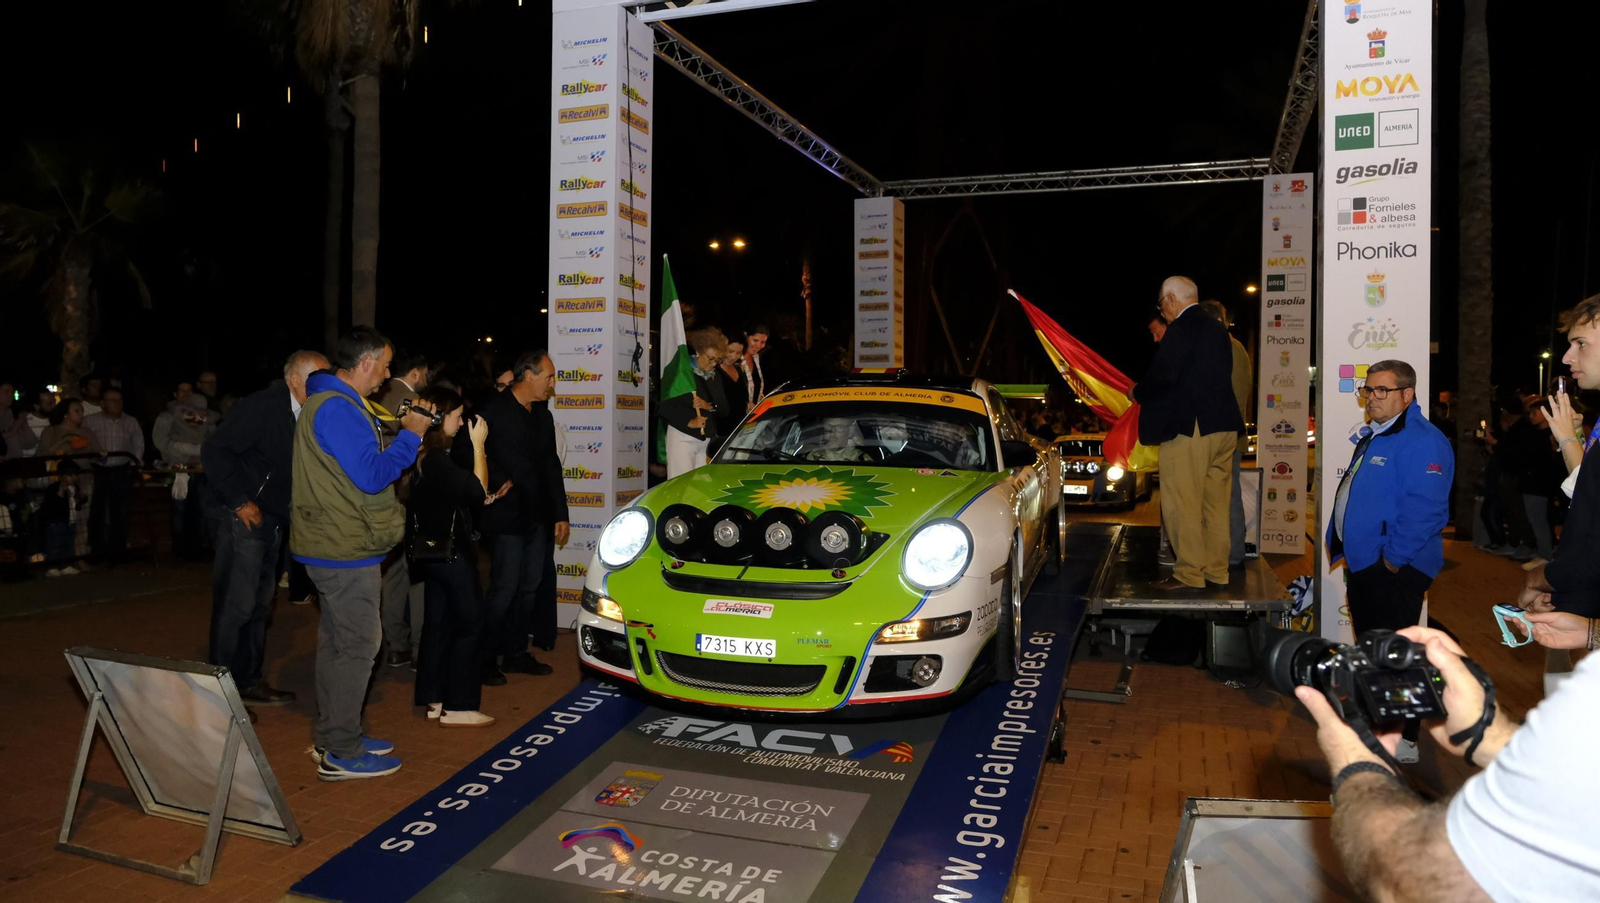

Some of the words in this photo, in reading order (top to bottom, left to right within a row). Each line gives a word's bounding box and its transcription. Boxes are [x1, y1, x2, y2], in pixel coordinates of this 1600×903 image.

[573, 37, 608, 47] MICHELIN
[1344, 61, 1385, 71] Ayuntamiento
[561, 82, 608, 94] Rallycar
[1335, 72, 1420, 100] MOYA
[568, 107, 599, 119] Recalvi
[1338, 125, 1371, 138] UNED
[572, 133, 607, 143] MICHELIN
[1335, 157, 1419, 184] gasolia
[560, 178, 606, 190] Rallycar
[567, 204, 597, 216] Recalvi
[1369, 203, 1416, 212] Fornieles
[1369, 214, 1378, 224] &
[1380, 213, 1416, 223] albesa
[1388, 221, 1416, 229] seguros
[1337, 241, 1417, 261] Phonika
[1267, 256, 1306, 267] MOYA
[558, 273, 604, 286] Rallycar
[565, 299, 596, 311] Recalvi
[1266, 297, 1305, 308] gasolia
[1267, 334, 1305, 346] Phonika
[1347, 323, 1400, 350] Enix
[557, 369, 603, 382] Rallycar
[801, 391, 851, 400] AUTOMÓVIL
[854, 390, 880, 398] CLUB
[564, 396, 595, 407] Recalvi
[1262, 533, 1299, 547] argar
[556, 564, 588, 577] Rallyc
[704, 636, 737, 653] 7315
[744, 640, 774, 656] KXS
[653, 737, 728, 753] FEDERACIÓN
[730, 746, 750, 757] DE
[749, 749, 860, 768] AUTOMOVILISMO
[743, 755, 823, 772] COMUNITAT
[824, 764, 906, 782] VALENCIANA
[669, 785, 836, 818] DIPUTACIÓN
[660, 798, 702, 816] DE
[704, 804, 820, 832] ALMERÍA
[640, 849, 739, 876] COSTA
[741, 865, 783, 884] DE
[588, 863, 767, 903] ALMERÍA
